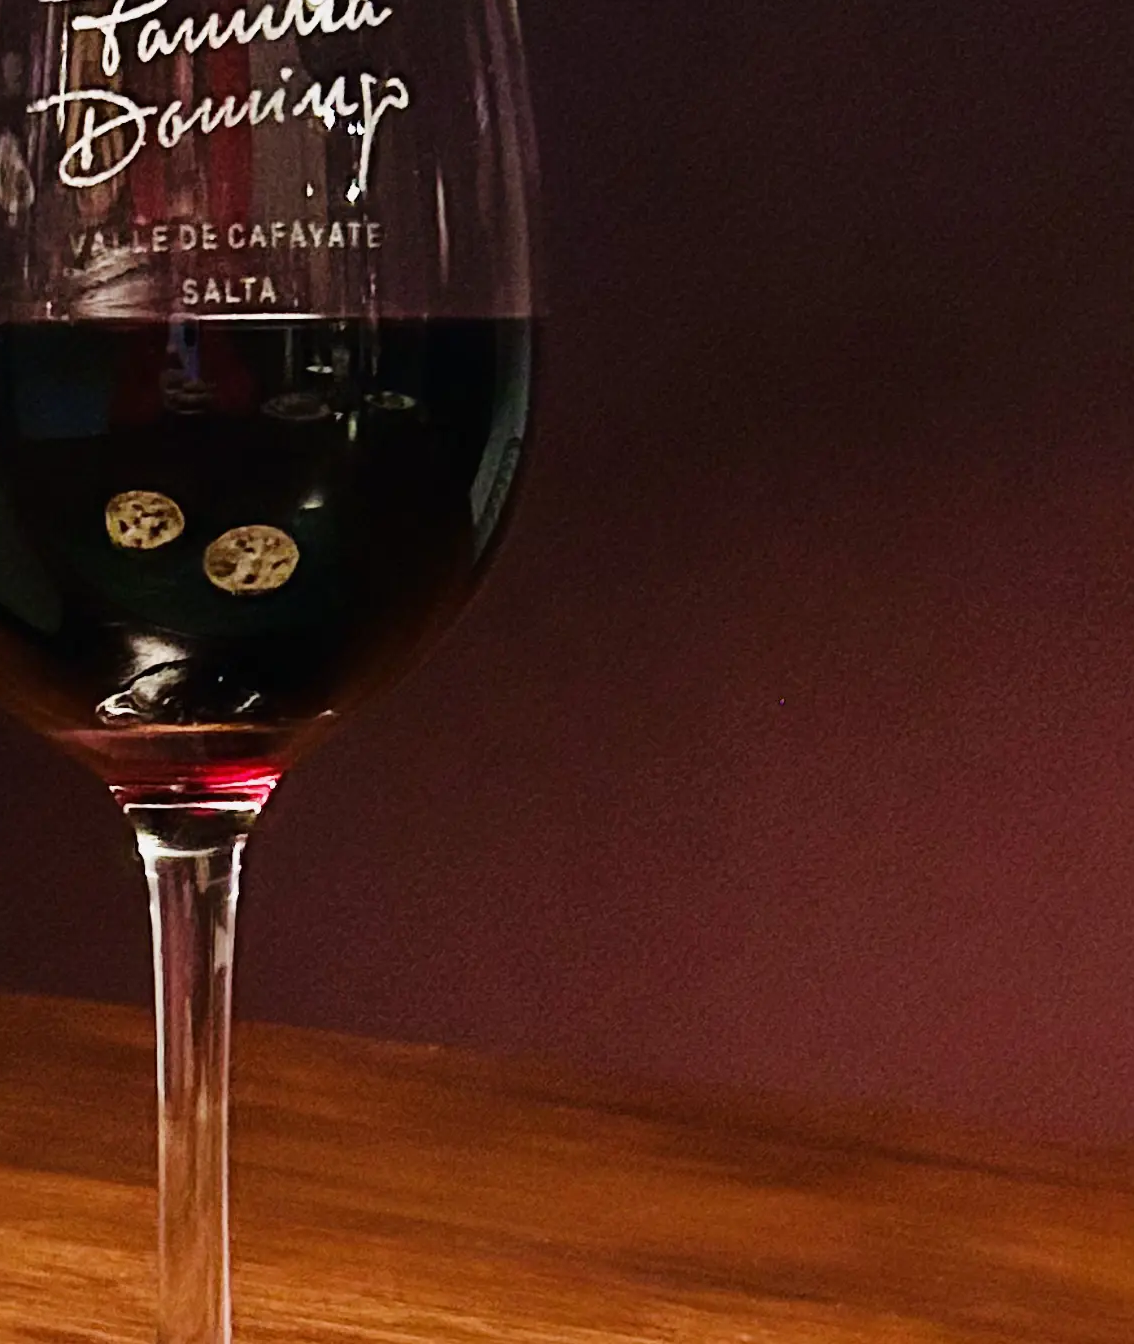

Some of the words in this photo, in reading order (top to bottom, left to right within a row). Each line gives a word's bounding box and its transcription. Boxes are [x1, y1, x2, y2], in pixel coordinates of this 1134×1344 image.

[70, 224, 168, 256] VALLE
[182, 223, 216, 250] DE
[227, 221, 382, 250] CAFAYATE
[181, 277, 276, 306] SALTA
